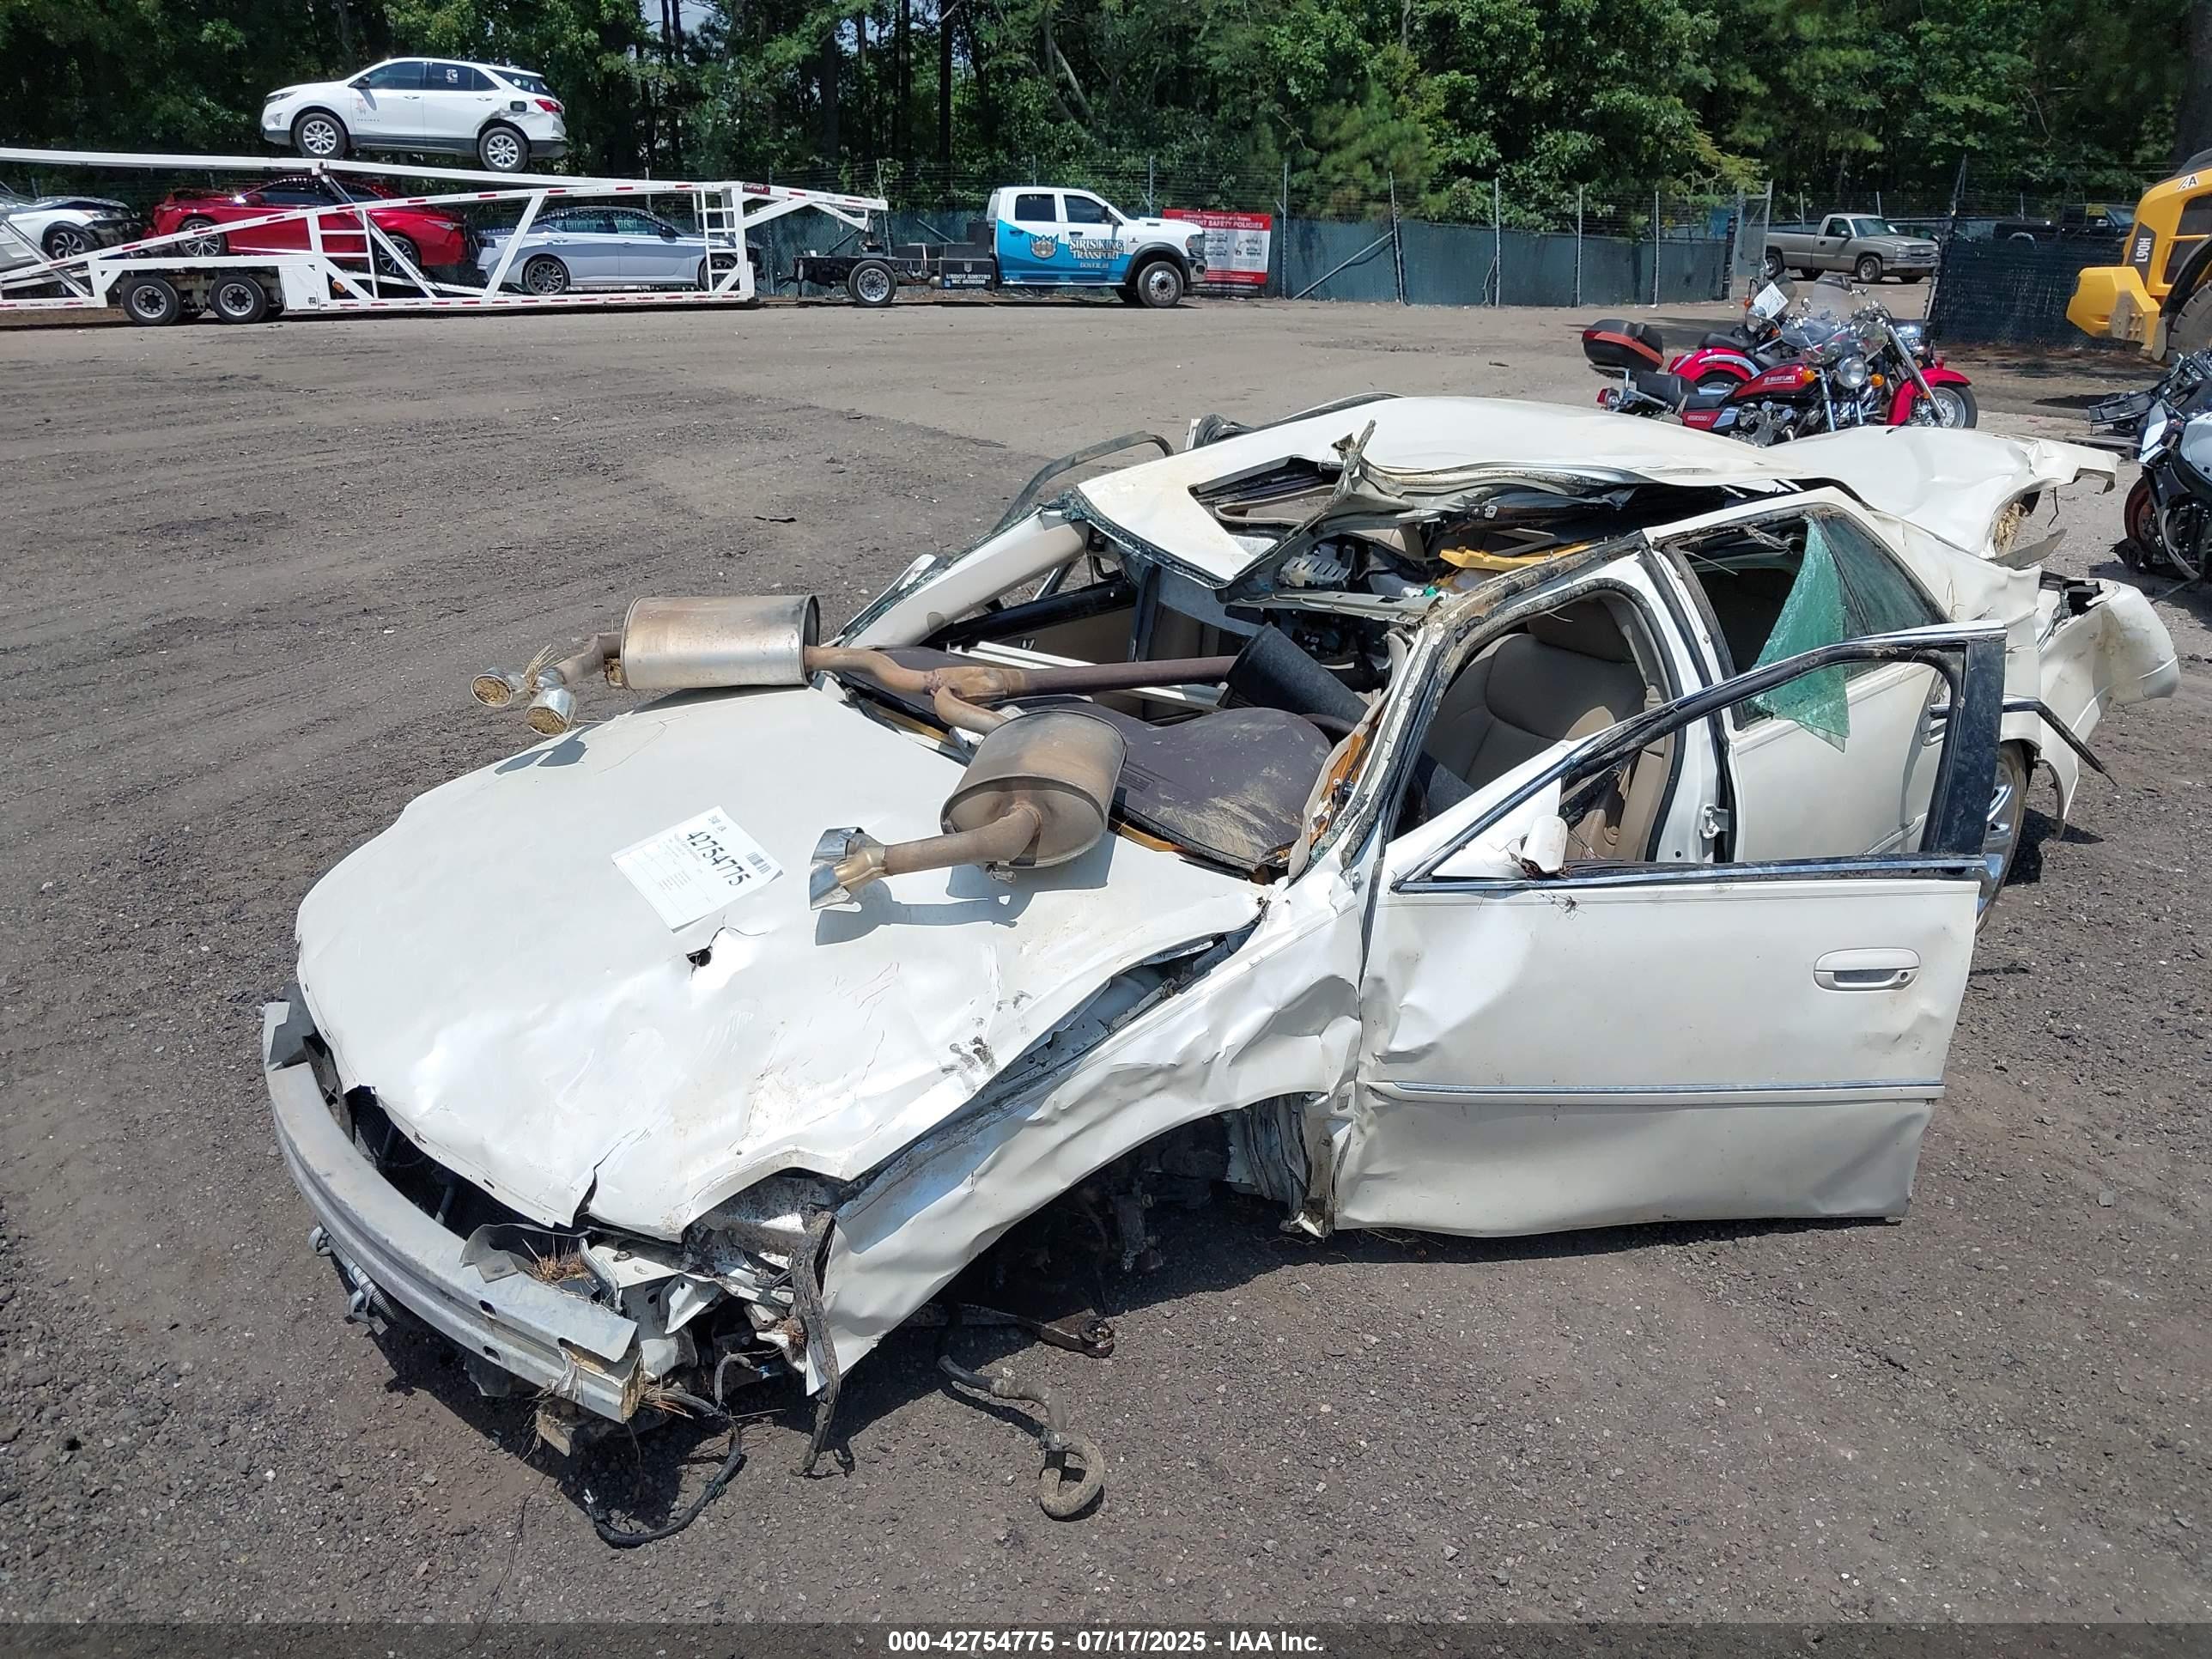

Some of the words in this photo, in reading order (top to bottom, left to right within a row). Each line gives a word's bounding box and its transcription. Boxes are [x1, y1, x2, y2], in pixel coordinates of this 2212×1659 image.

[1208, 219, 1233, 228] SAFETY
[1233, 221, 1264, 229] POLICIES
[2135, 238, 2151, 262] L90H
[687, 831, 751, 886] 42754775
